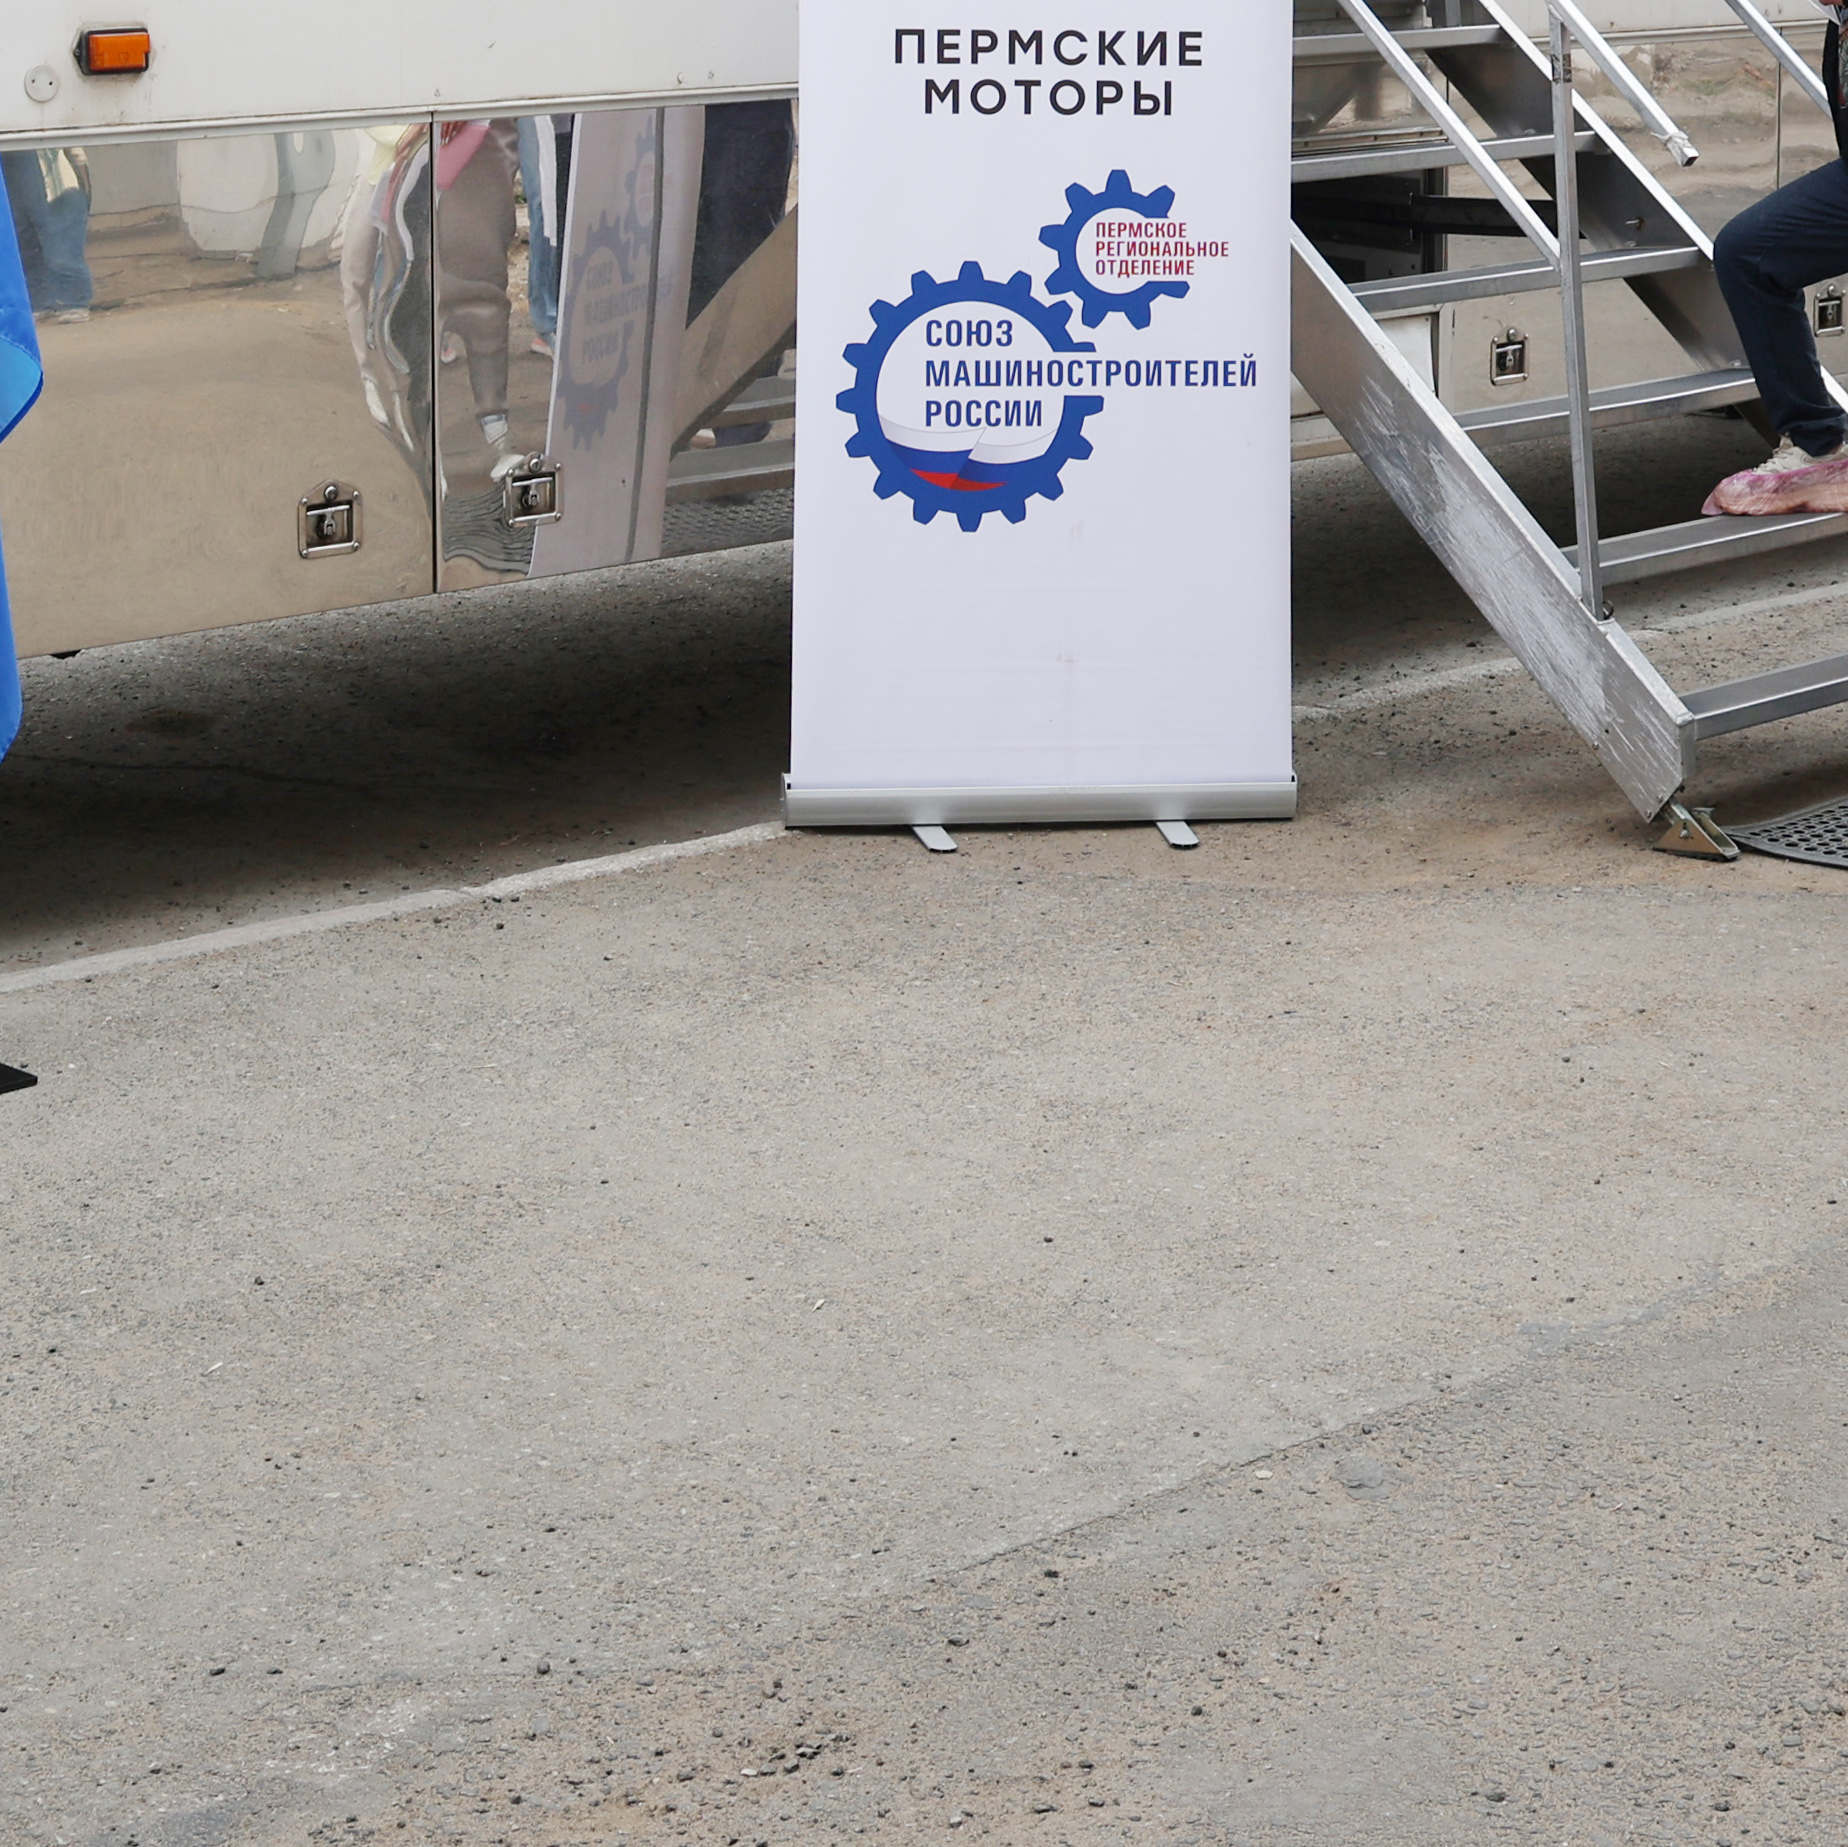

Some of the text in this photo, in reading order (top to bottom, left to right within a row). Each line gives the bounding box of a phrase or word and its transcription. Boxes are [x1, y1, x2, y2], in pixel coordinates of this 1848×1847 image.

[894, 28, 1203, 67] ПЕРМСКИЕ
[924, 78, 1172, 116] МОТОРЫ
[1096, 222, 1187, 239] ПЕРМСКОЕ
[1095, 241, 1229, 258] РЕГИОНАЛЬНОЕ
[1095, 259, 1195, 278] ОТДЕЛЕНИЕ
[925, 320, 1014, 348] СОЮЗ
[925, 353, 1258, 388] МАШИНОСТРОИТЕЛЕЙ
[925, 399, 1043, 428] РОССИИ
